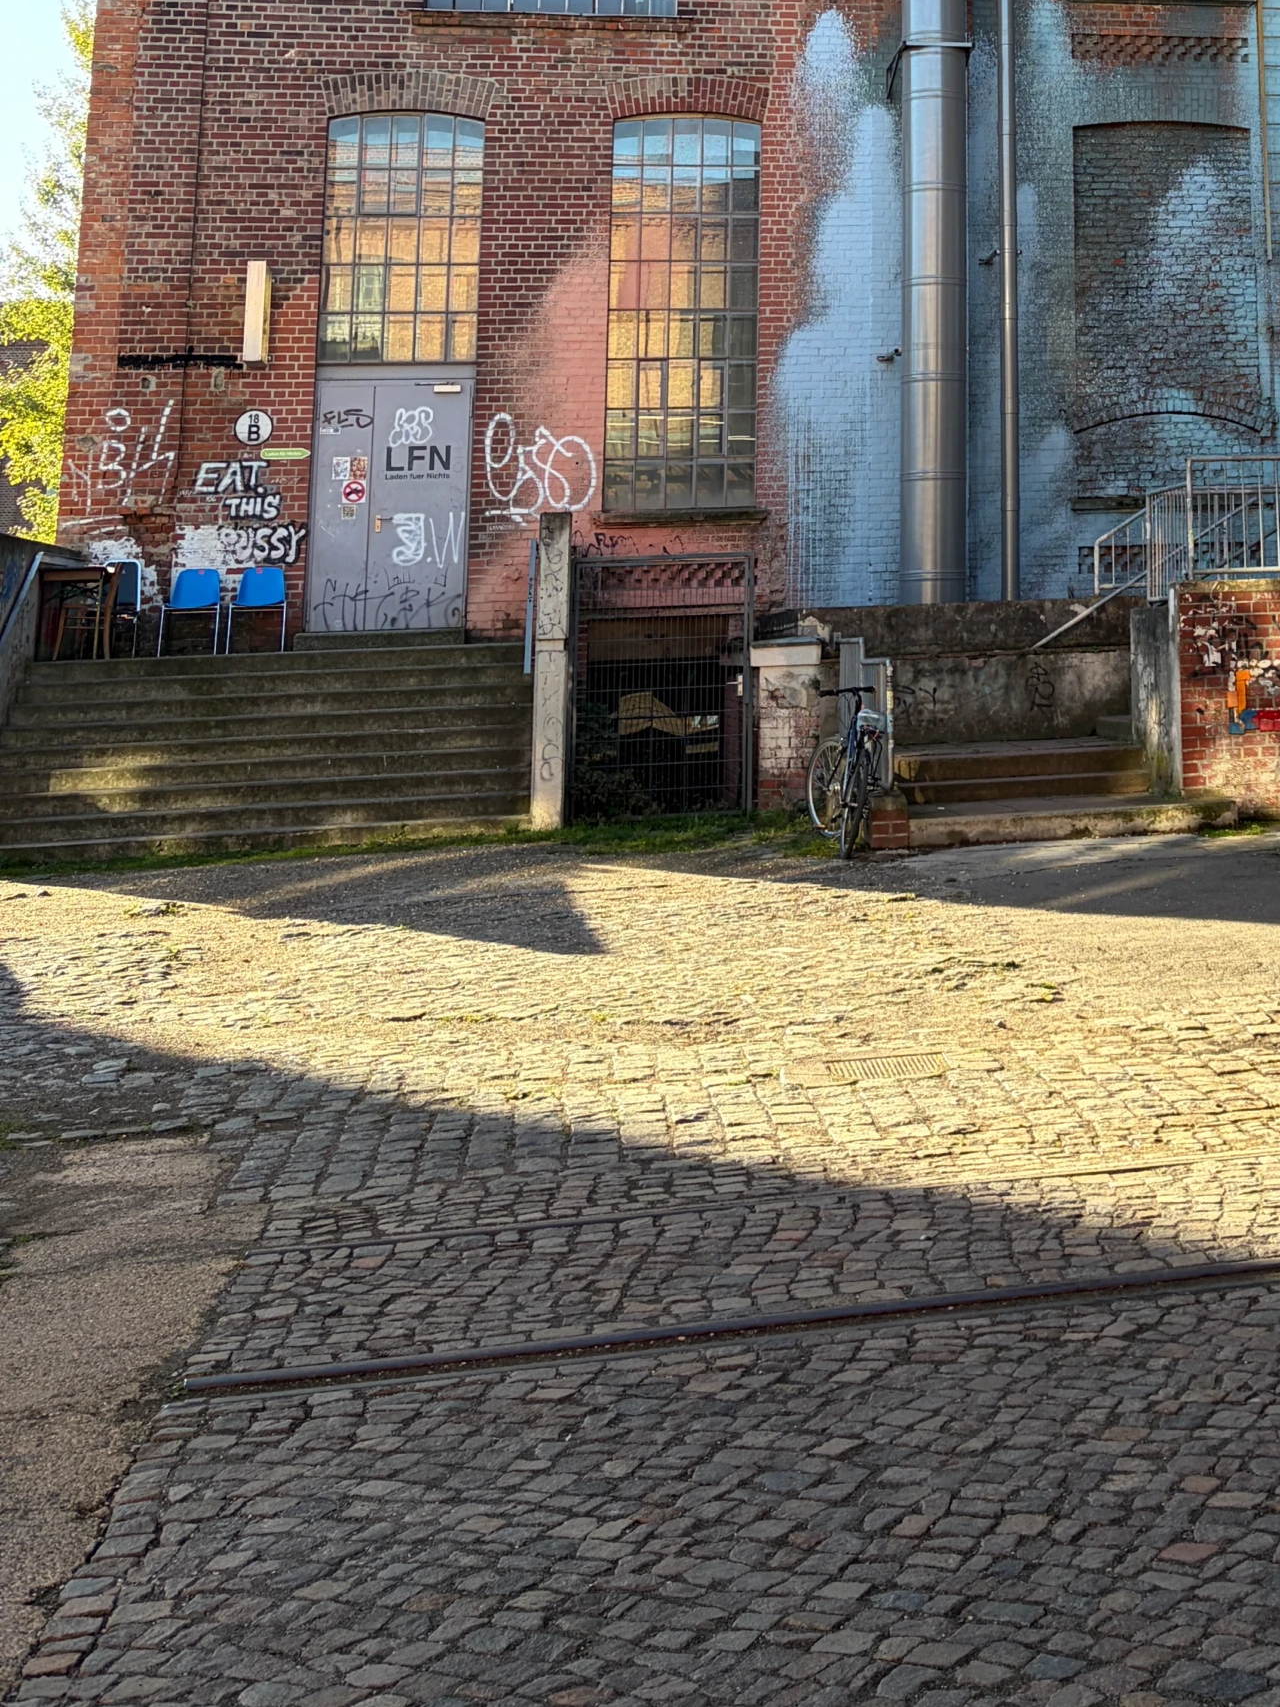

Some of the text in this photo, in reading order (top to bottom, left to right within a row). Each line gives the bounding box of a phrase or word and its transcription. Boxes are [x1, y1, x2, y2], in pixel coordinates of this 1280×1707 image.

[247, 413, 260, 424] 18
[247, 424, 261, 442] B
[385, 445, 451, 472] LFN
[384, 472, 451, 481] Laden fuer Nichts
[223, 493, 281, 521] THIS
